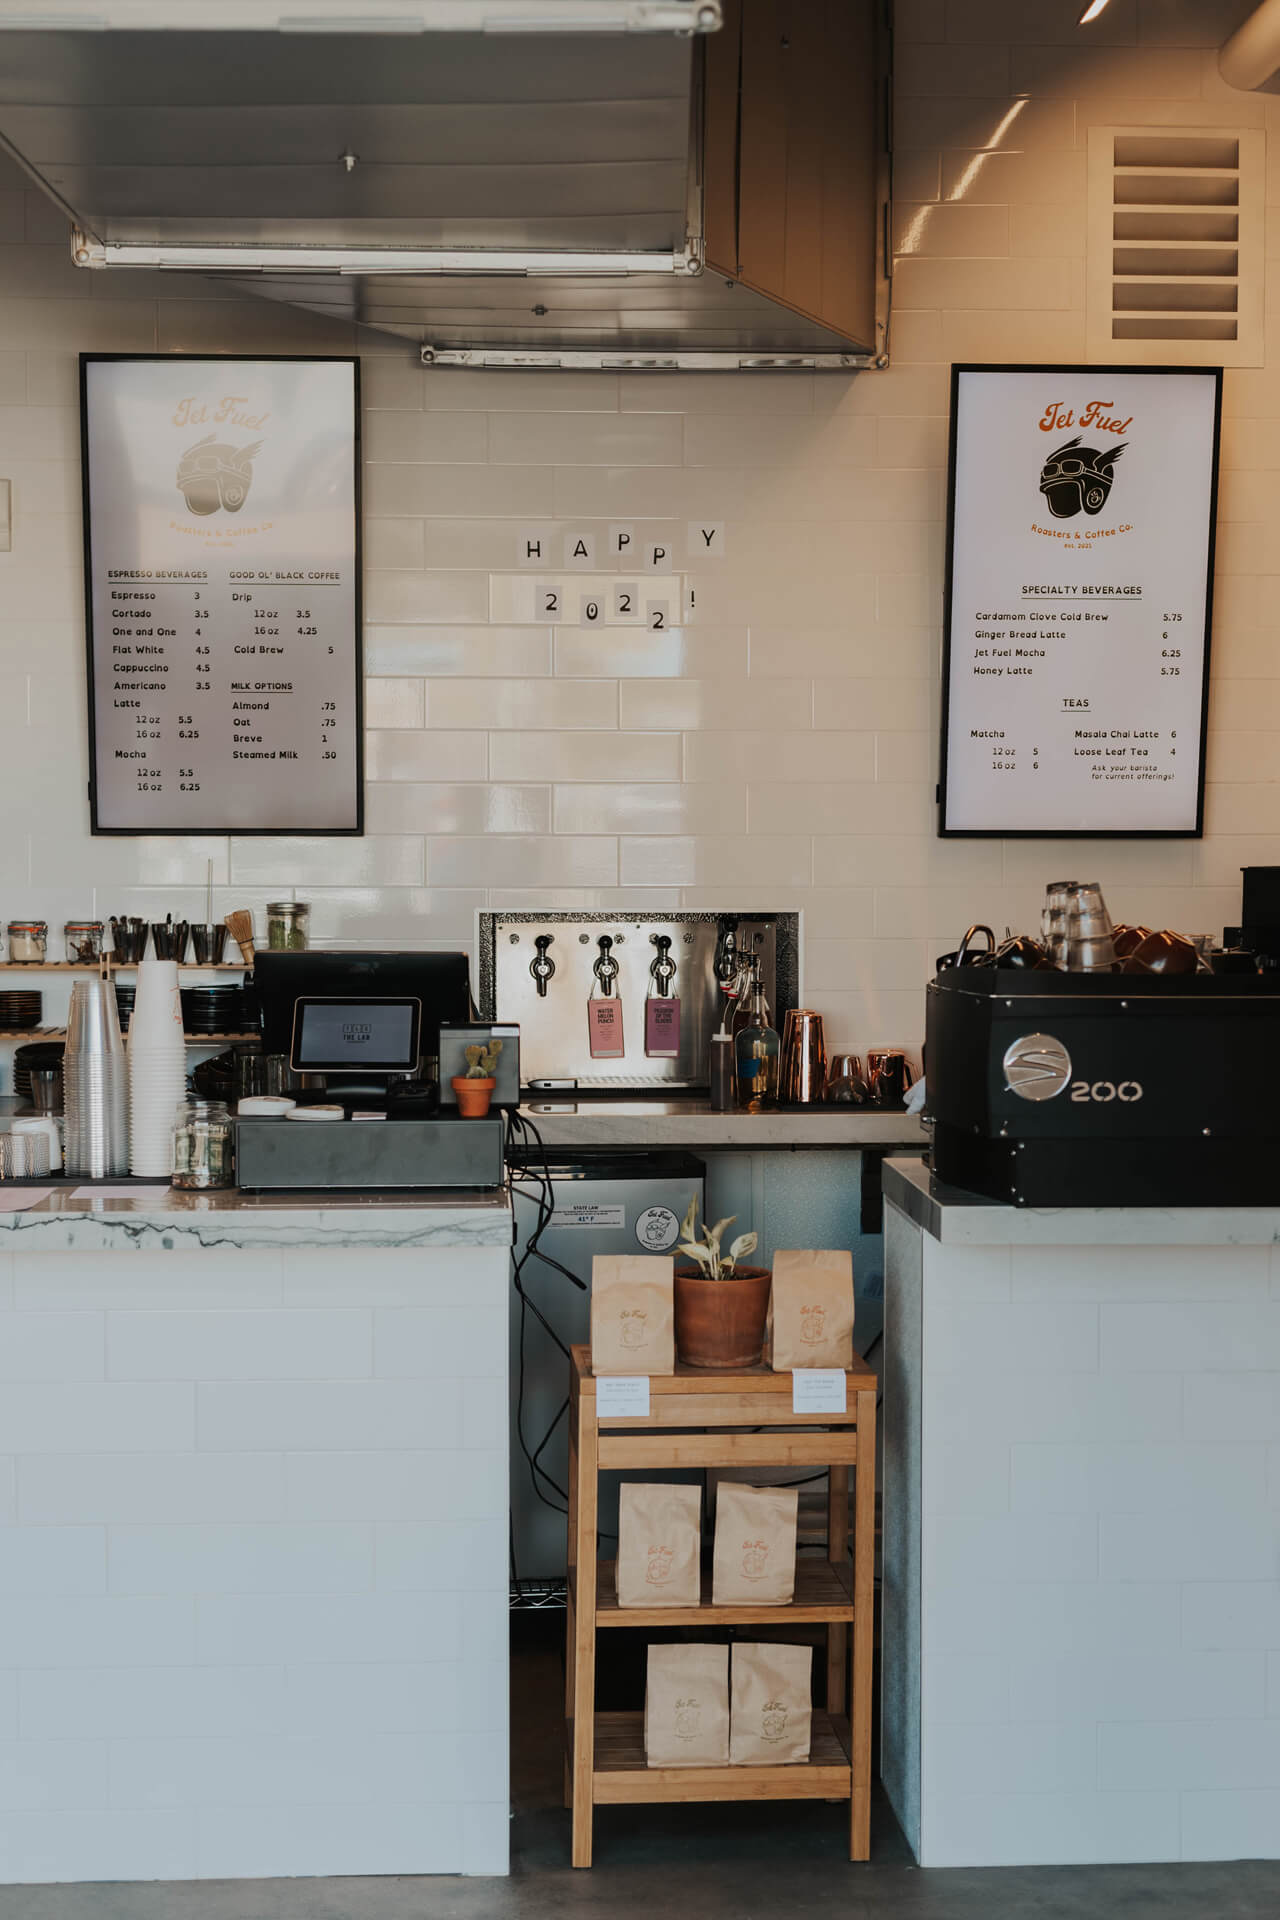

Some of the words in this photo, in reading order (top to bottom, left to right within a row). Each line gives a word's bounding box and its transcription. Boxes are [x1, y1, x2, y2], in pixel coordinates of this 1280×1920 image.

[213, 396, 271, 431] Fuel
[1038, 401, 1075, 432] Jet
[1079, 401, 1133, 435] Fuel
[1031, 523, 1071, 539] Roasters
[1074, 531, 1081, 539] &
[1085, 528, 1116, 539] Coffee
[107, 570, 153, 578] ESPRESSO
[155, 571, 208, 579] BEVERAGES
[229, 571, 255, 579] GOOD
[275, 571, 305, 580] BLACK
[308, 572, 341, 580] COFFEE
[1021, 585, 1078, 595] SPECIALTY
[1082, 586, 1143, 595] BEVERAGES
[111, 591, 156, 601] Espresso
[194, 592, 200, 600] 3
[231, 592, 253, 603] Drip
[111, 609, 152, 618] Cortado
[194, 609, 209, 618] 3.5
[254, 609, 266, 618] 12
[296, 609, 311, 618] 3.5
[975, 612, 1026, 621] Cardamom
[1029, 612, 1057, 621] Clove
[1060, 612, 1082, 621] Cold
[1084, 612, 1109, 621] Brew
[1163, 613, 1183, 622] 5.75
[112, 627, 132, 636] One
[135, 627, 154, 636] and
[157, 627, 177, 636] One
[195, 628, 202, 636] 4
[254, 626, 266, 635] 16
[297, 627, 318, 635] 4.25
[974, 630, 1006, 640] Ginger
[1009, 630, 1037, 639] Bread
[1040, 630, 1067, 639] Latte
[1162, 631, 1168, 640] 6
[112, 645, 132, 654] Flat
[135, 645, 165, 654] White
[195, 646, 210, 655] 4.5
[233, 645, 256, 654] Cold
[259, 645, 284, 654] Brew
[327, 646, 334, 655] 5
[974, 648, 989, 658] Jet
[992, 648, 1012, 657] Fuel
[1015, 648, 1046, 657] Mocha
[1161, 649, 1181, 658] 6.25
[113, 663, 169, 673] Cappuccino
[195, 664, 211, 673] 4.5
[973, 666, 1004, 676] Honey
[1007, 667, 1033, 675] Latte
[1160, 667, 1180, 676] 5.75
[113, 681, 167, 690] Americano
[195, 682, 211, 690] 3.5
[231, 682, 251, 690] MILK
[254, 682, 293, 690] OPTIONS
[114, 699, 141, 708] Latte
[232, 701, 270, 710] Almond
[321, 702, 336, 711] .75
[1062, 698, 1090, 707] TEAS
[135, 715, 147, 724] 12
[178, 715, 193, 724] 5.5
[233, 718, 251, 727] Oat
[321, 718, 336, 727] .75
[136, 730, 148, 739] 16
[179, 730, 200, 739] 6.25
[233, 734, 263, 743] Breve
[321, 734, 328, 743] 1
[970, 730, 1005, 738] Matcha
[1074, 730, 1107, 738] Masala
[1110, 730, 1131, 738] Chai
[1133, 730, 1159, 738] Latte
[1170, 730, 1177, 738] 6
[115, 750, 147, 759] Mocha
[232, 750, 276, 759] Steamed
[279, 750, 299, 759] Milk
[321, 751, 337, 760] .50
[992, 747, 1003, 755] 12
[1033, 747, 1039, 756] 5
[1074, 748, 1102, 756] Loose
[1105, 748, 1126, 756] Leaf
[1130, 748, 1149, 756] Tea
[1170, 748, 1176, 756] 4
[992, 761, 1003, 770] 16
[1033, 761, 1039, 770] 6
[137, 768, 149, 777] 12
[179, 768, 194, 777] 5.5
[137, 782, 149, 791] 16
[150, 784, 162, 792] oz
[180, 783, 201, 792] 6.25
[1071, 1081, 1143, 1102] 200
